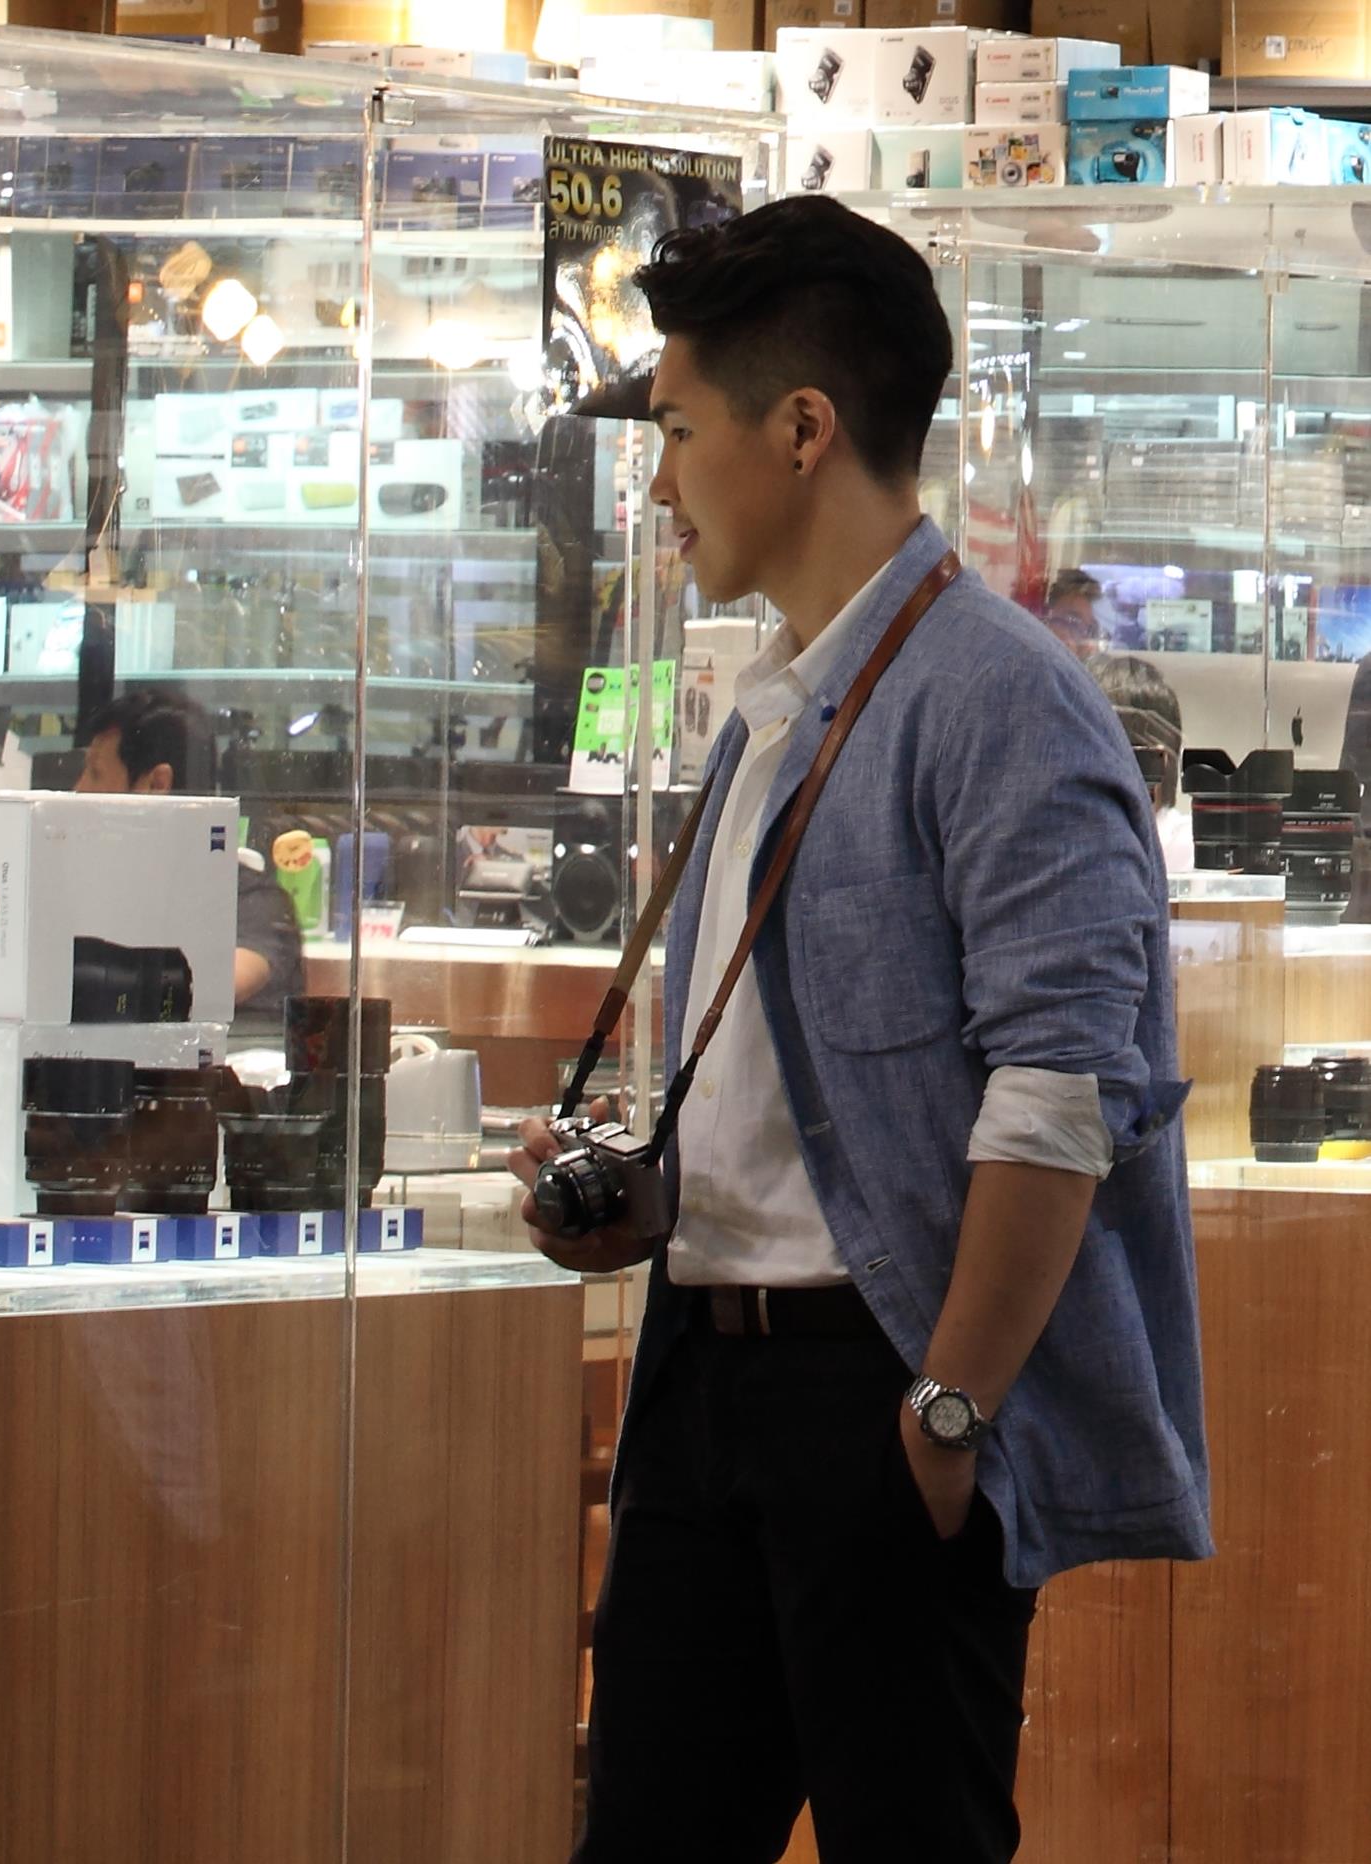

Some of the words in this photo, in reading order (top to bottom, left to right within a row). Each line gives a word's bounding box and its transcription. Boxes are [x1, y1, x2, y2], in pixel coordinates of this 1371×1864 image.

[549, 141, 605, 167] ULTRA
[610, 147, 648, 172] HIGH
[549, 169, 624, 219] 50.6
